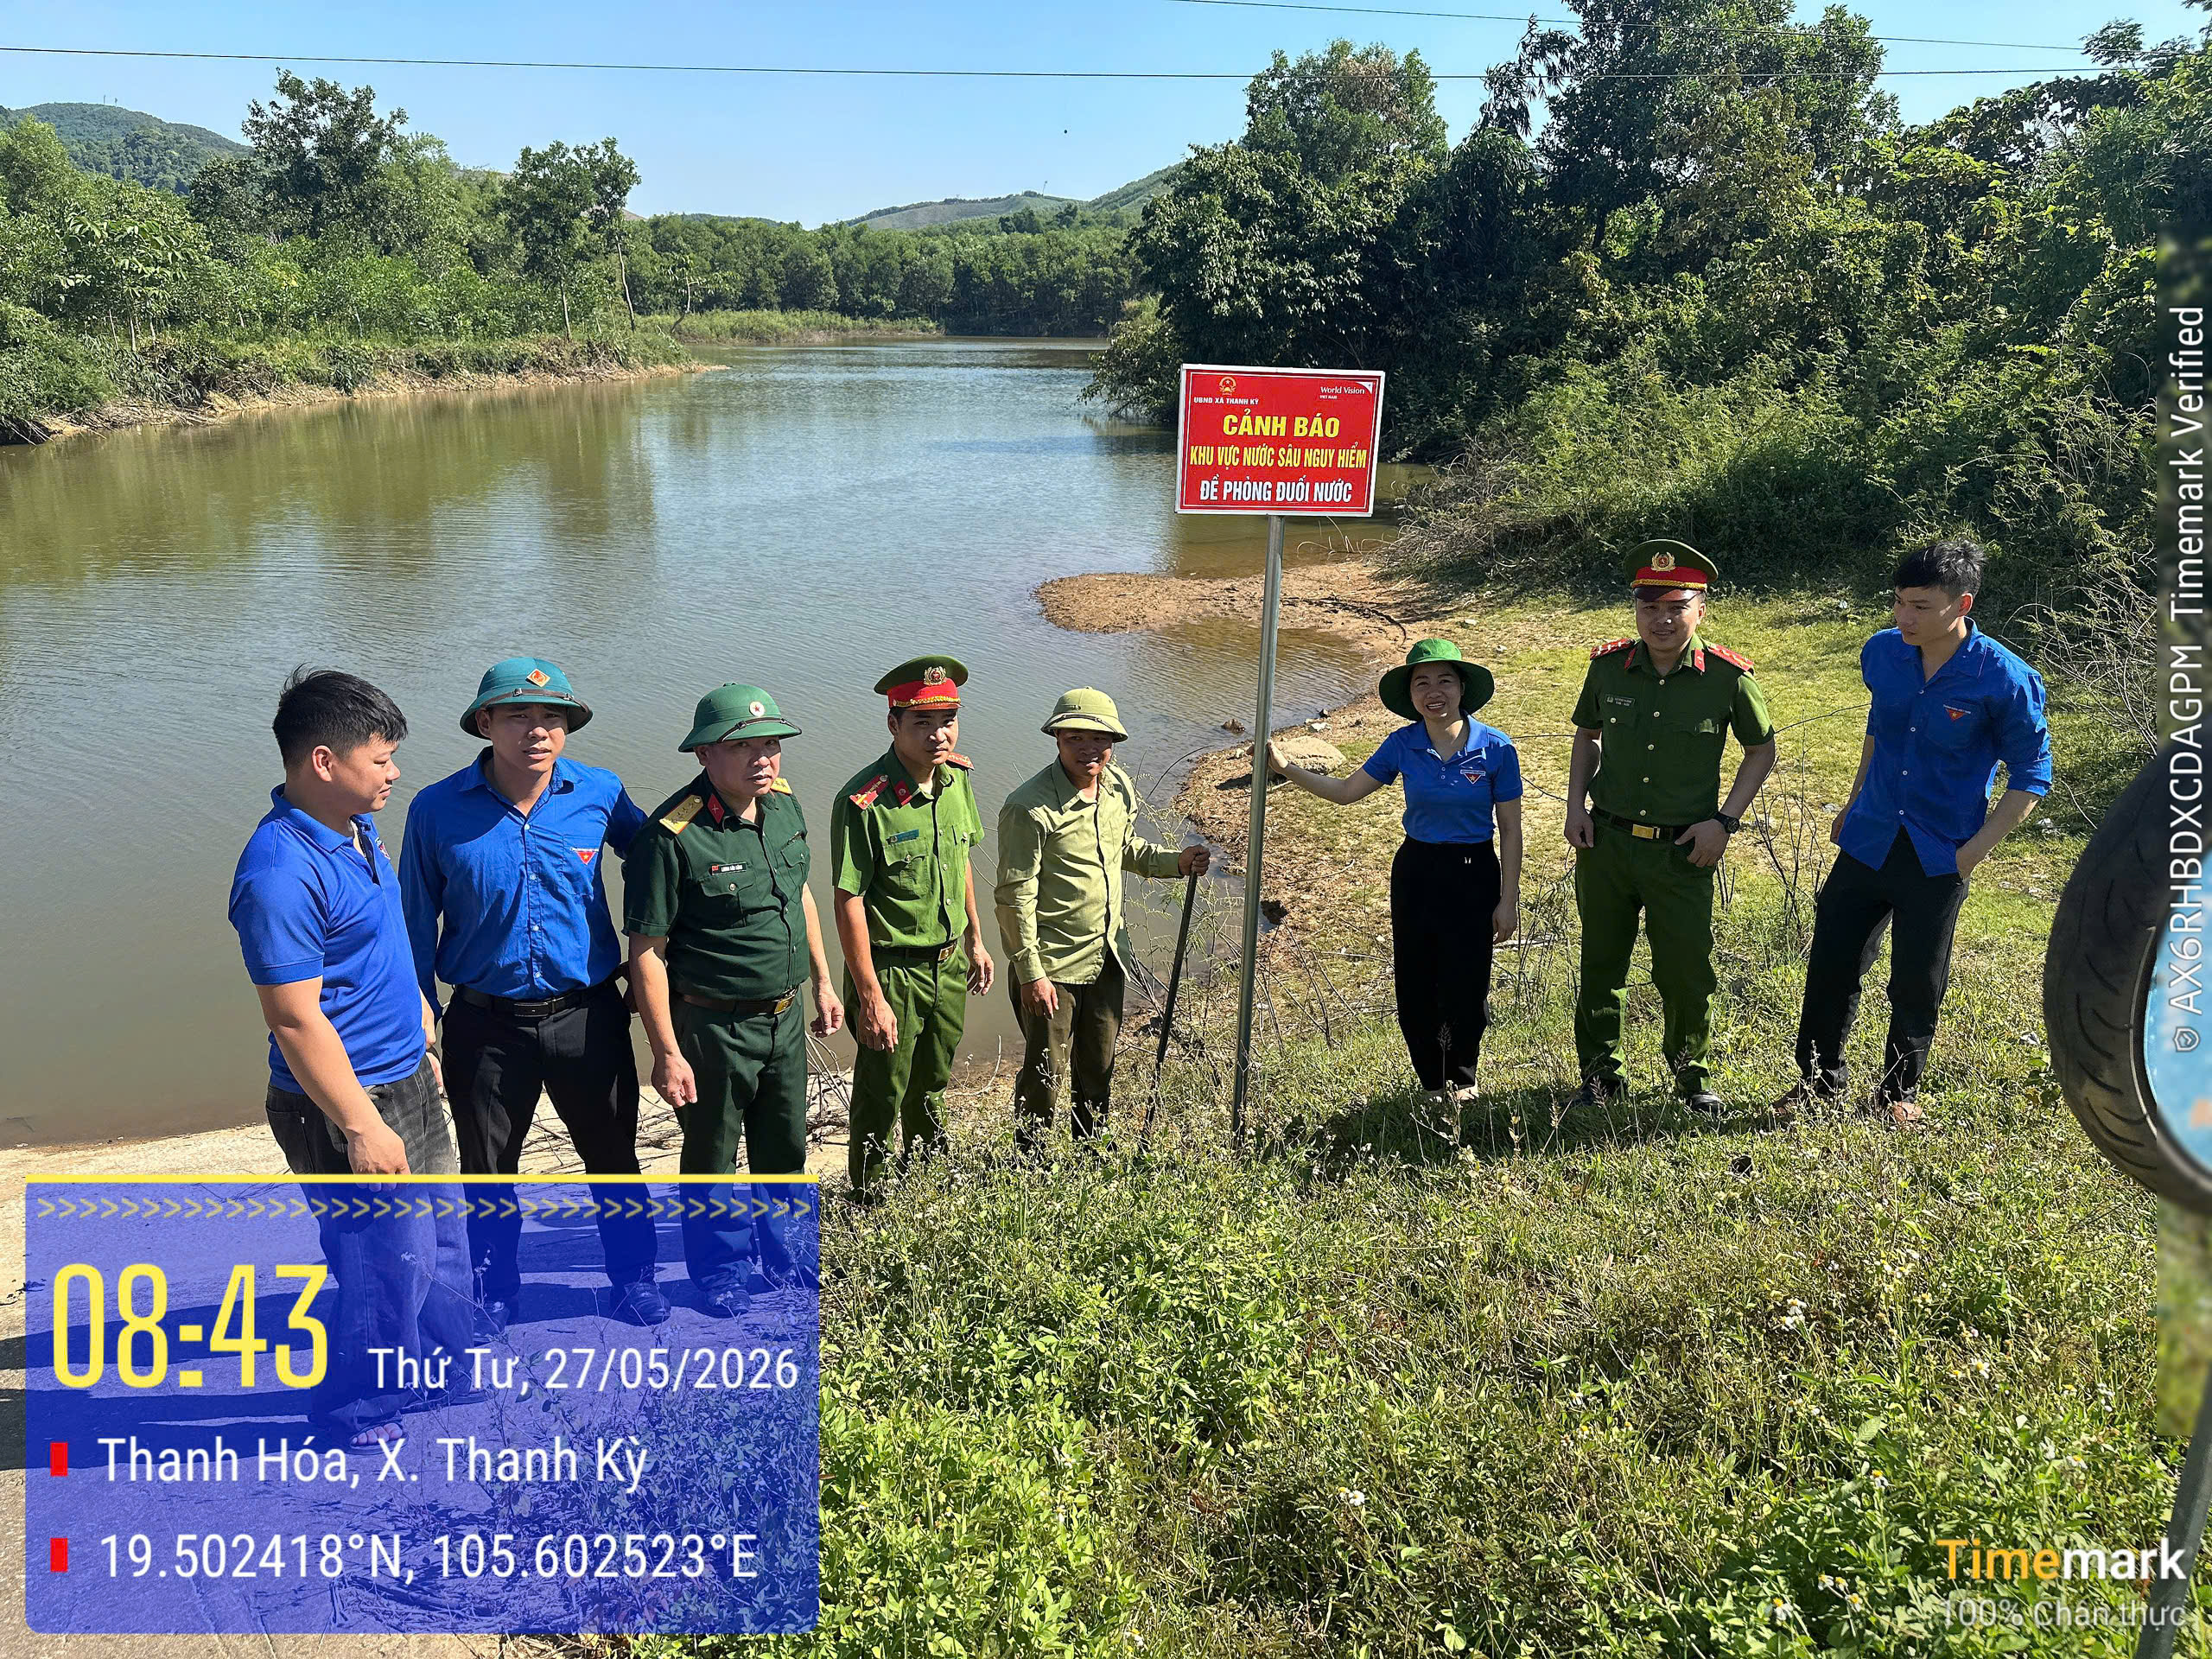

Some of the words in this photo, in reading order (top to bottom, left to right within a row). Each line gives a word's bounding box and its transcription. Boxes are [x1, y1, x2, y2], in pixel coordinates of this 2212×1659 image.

[1223, 408, 1287, 436] CẢNH
[1293, 412, 1340, 438] BÁO
[1190, 445, 1214, 466] KHU
[1217, 446, 1240, 470] VỰC
[1243, 442, 1275, 467] NƯỚC
[1278, 443, 1301, 467] SÂU
[1304, 448, 1335, 468] NGUY
[1337, 442, 1368, 468] HIỂM
[1200, 474, 1220, 501] ĐỀ
[1223, 476, 1273, 502] PHÒNG
[1275, 474, 1310, 502] ĐUỐI
[1313, 478, 1353, 503] NƯỚC
